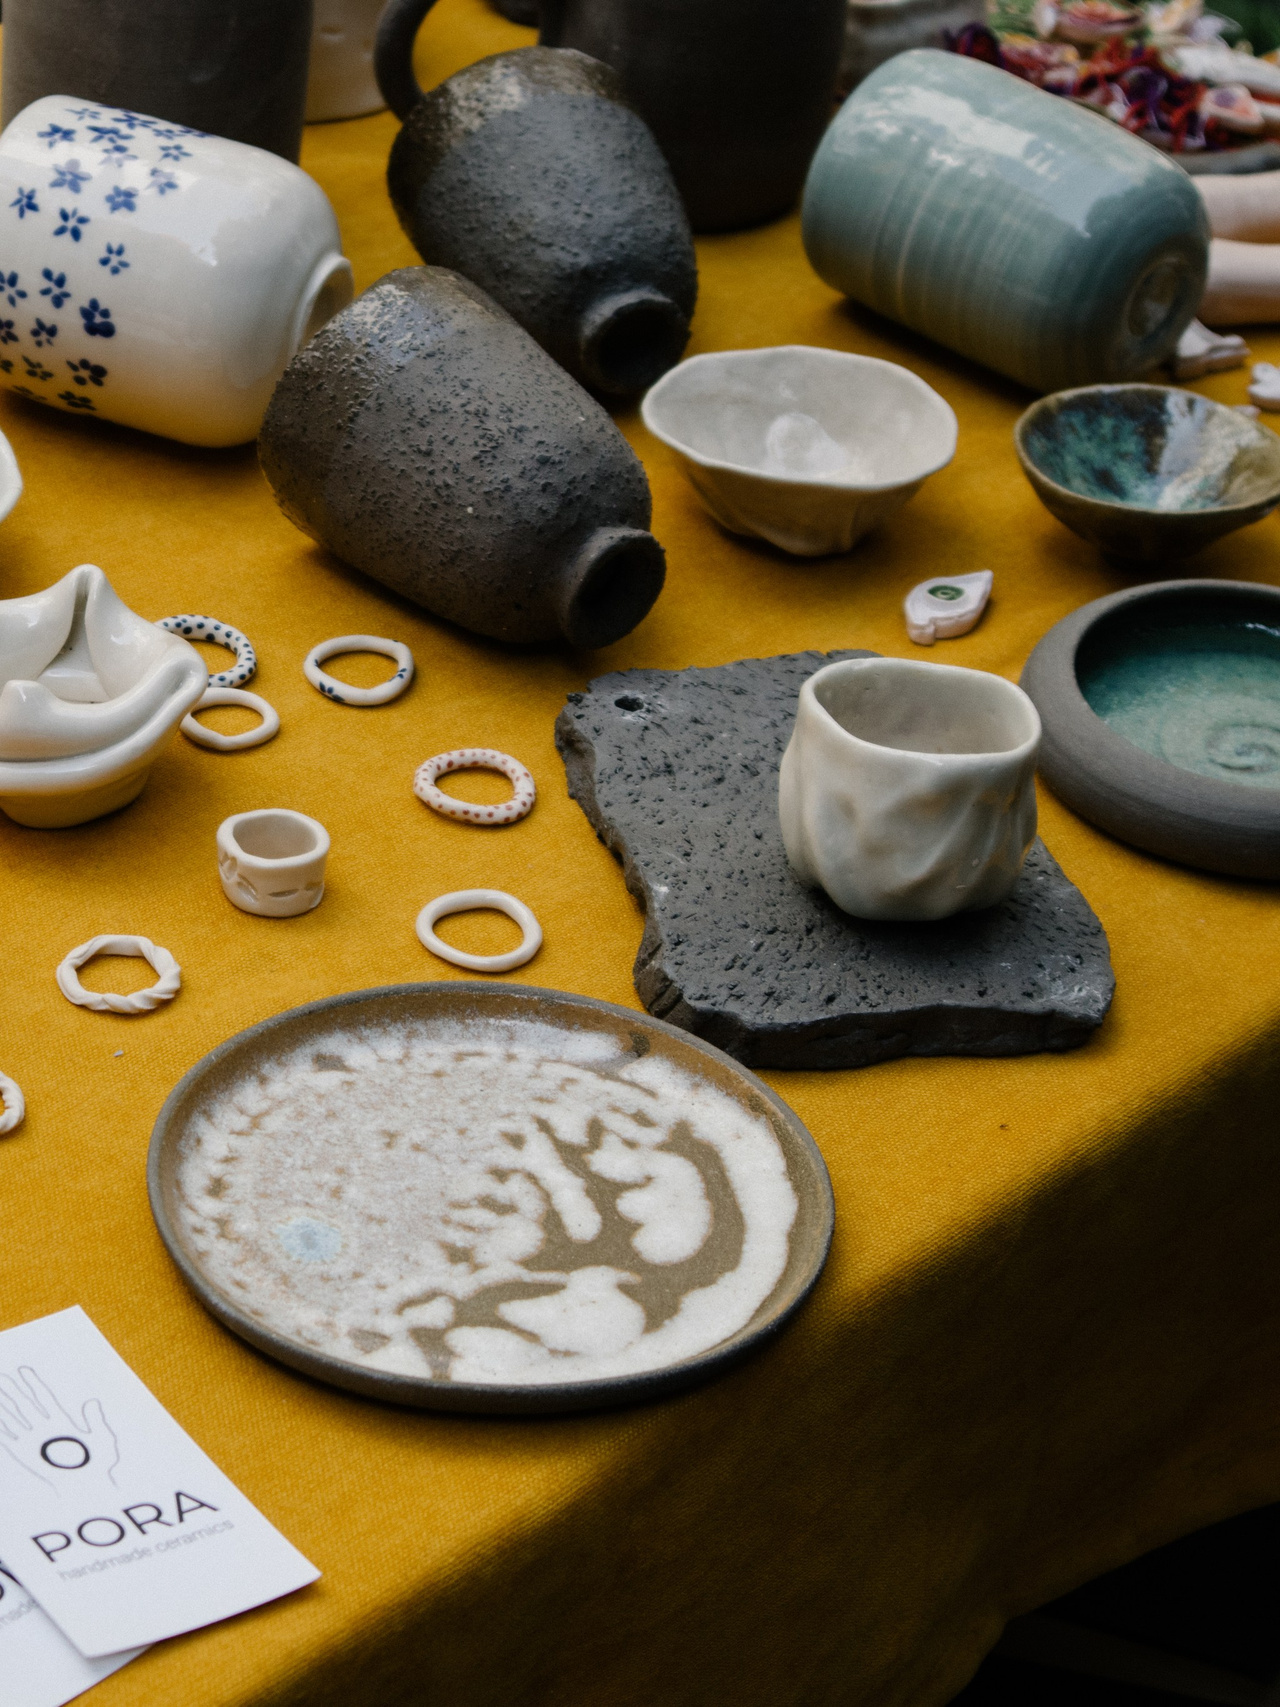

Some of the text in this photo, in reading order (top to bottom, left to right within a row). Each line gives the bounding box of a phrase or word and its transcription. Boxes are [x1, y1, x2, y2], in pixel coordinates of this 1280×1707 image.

[32, 1491, 218, 1562] PORA
[58, 1519, 234, 1580] handmade ceramics
